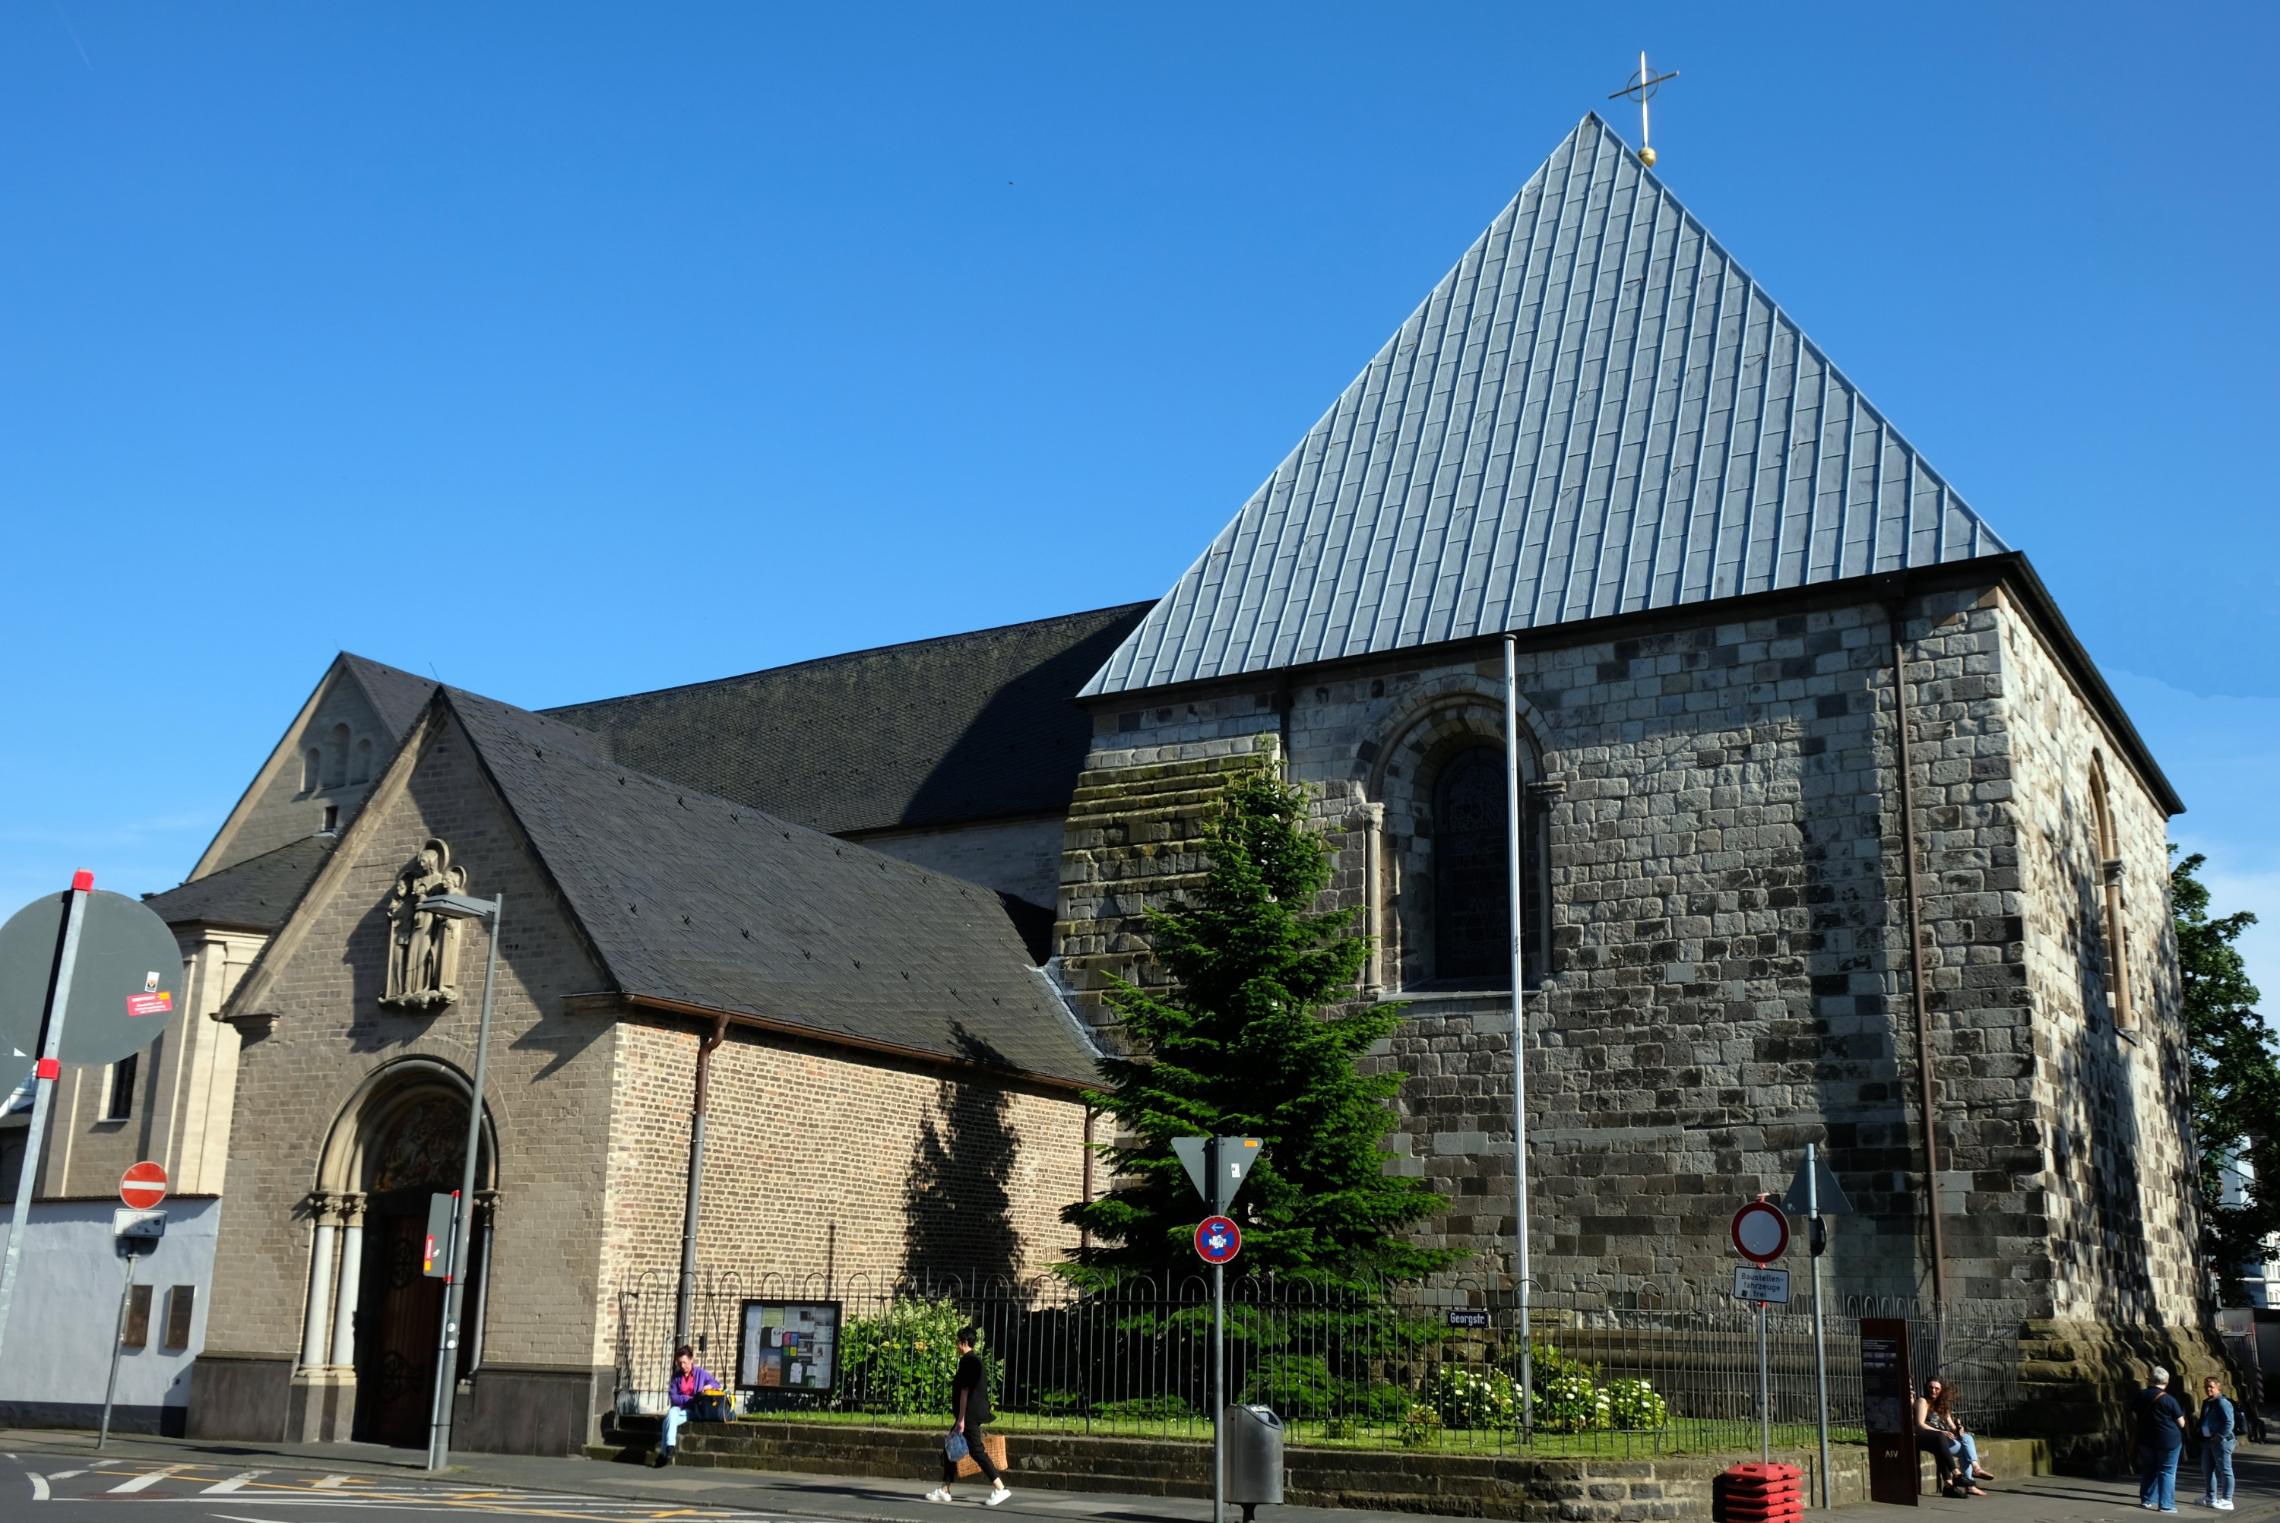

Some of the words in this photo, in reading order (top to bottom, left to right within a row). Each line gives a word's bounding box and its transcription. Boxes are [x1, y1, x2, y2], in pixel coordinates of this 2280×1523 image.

[1741, 1272, 1784, 1283] Baustellen-
[1743, 1281, 1780, 1292] fahrzeuge
[1450, 1312, 1485, 1326] Georgstr.
